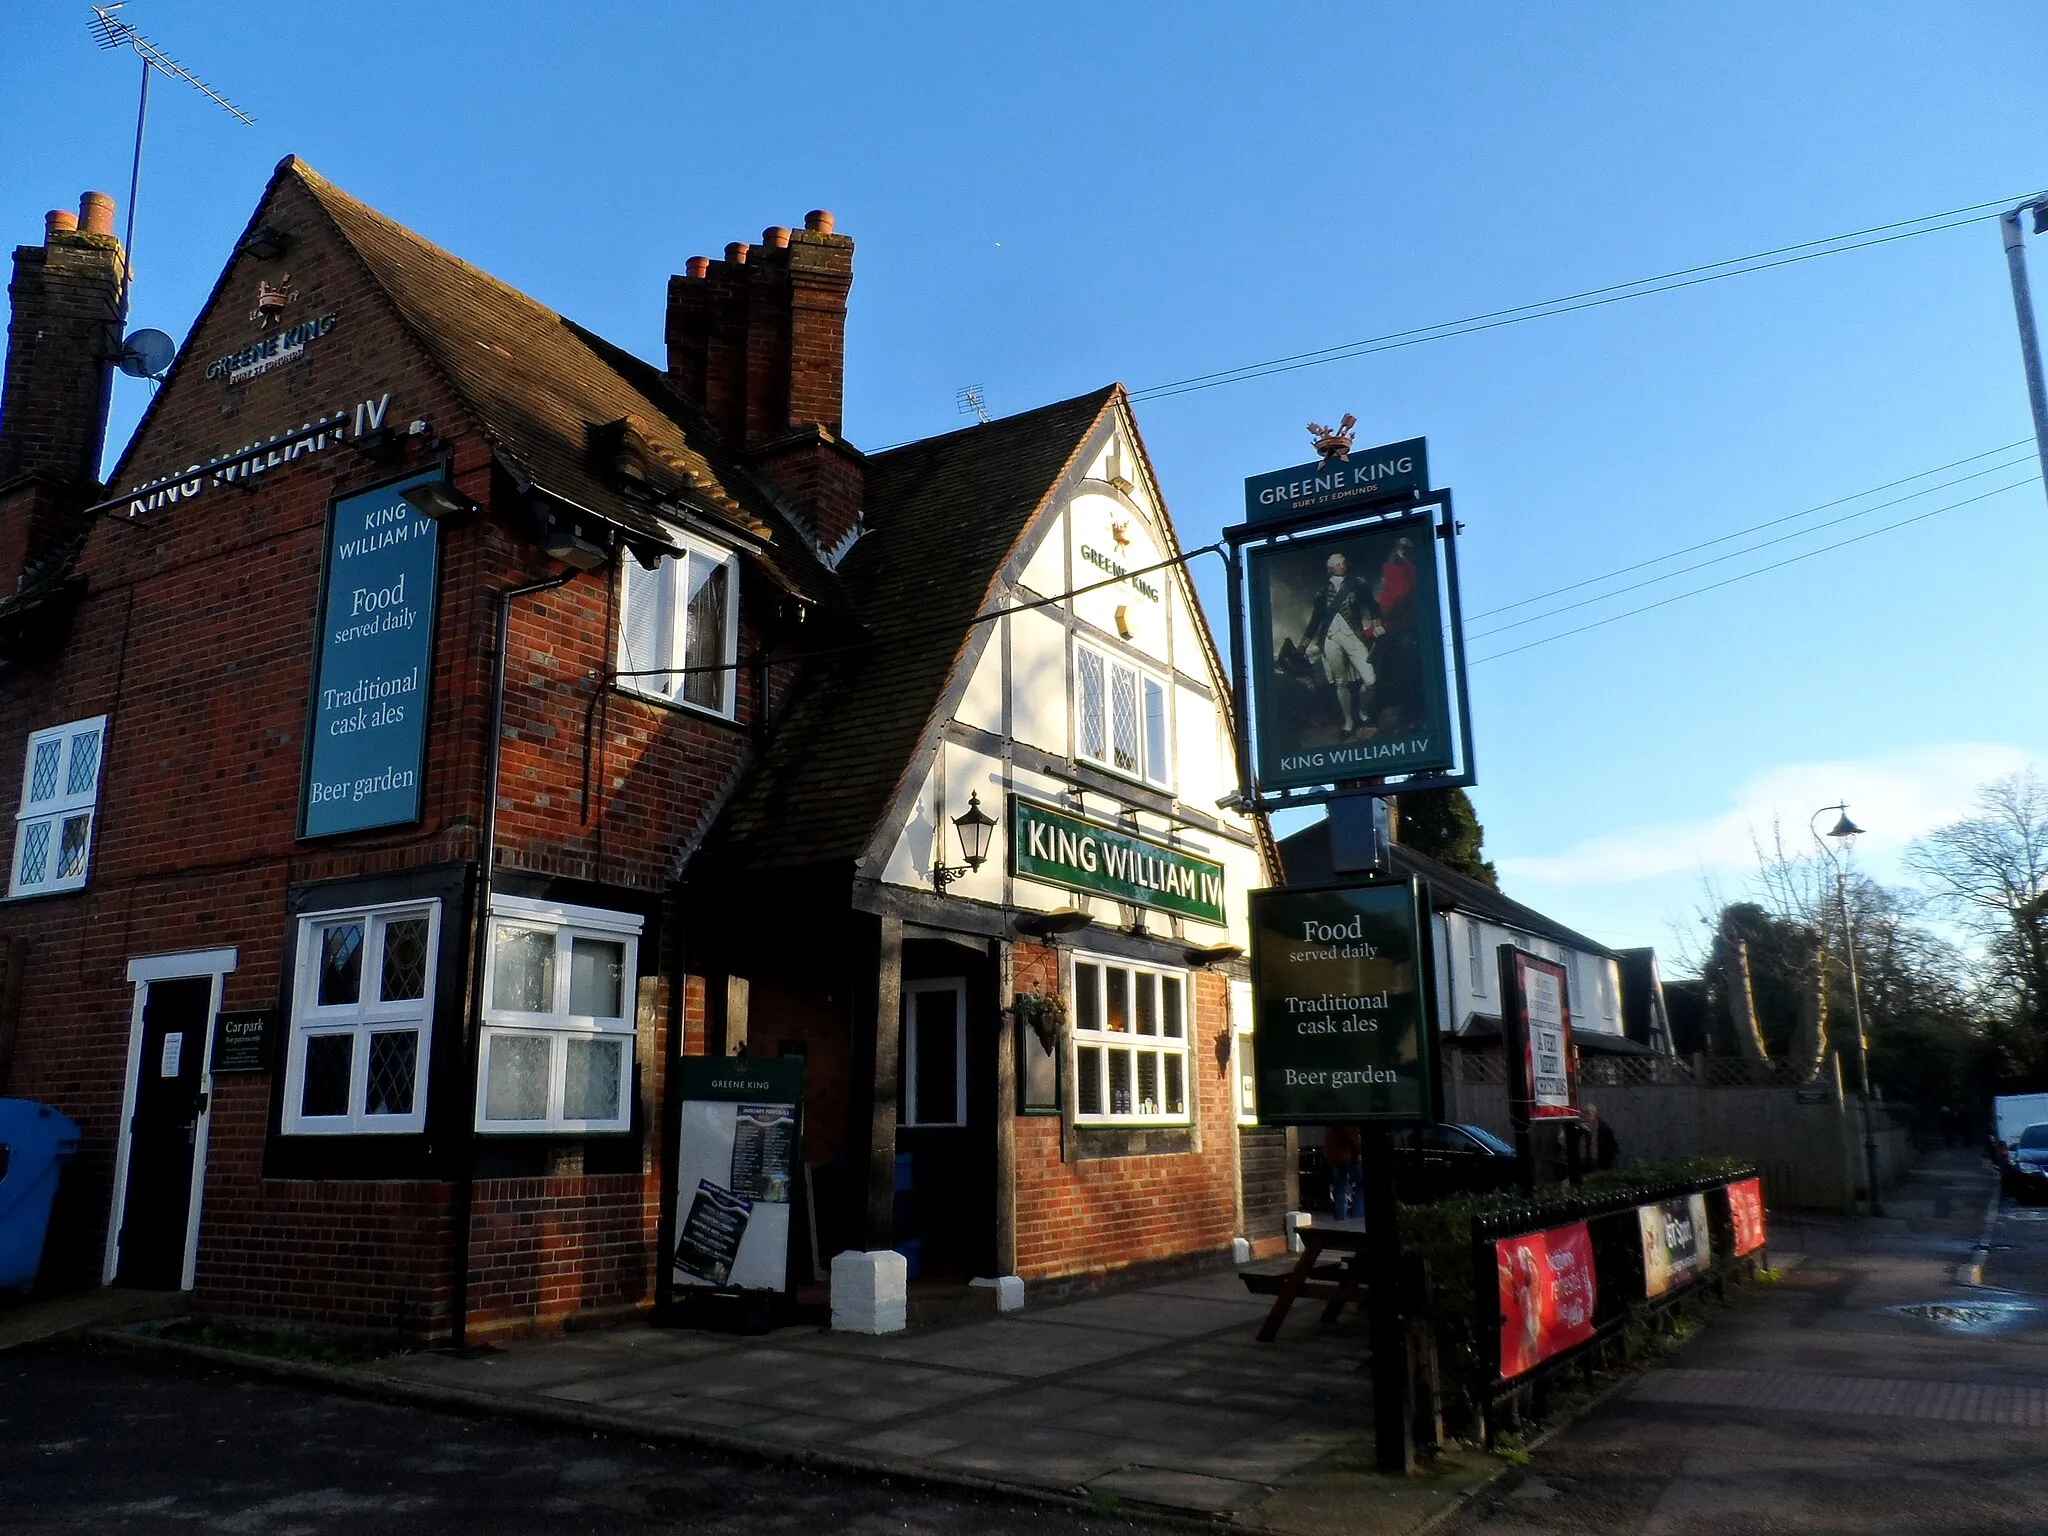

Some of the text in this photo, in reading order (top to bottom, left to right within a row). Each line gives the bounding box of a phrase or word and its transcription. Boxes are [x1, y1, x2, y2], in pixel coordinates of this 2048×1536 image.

[206, 314, 336, 380] GREENE KING
[129, 393, 391, 517] KING WILLIAM IV
[1260, 457, 1413, 505] GREENE KING
[1292, 484, 1378, 509] BURY ST EDMUNDS
[365, 503, 407, 530] KING
[339, 518, 431, 560] WILLIAM IV
[1081, 544, 1127, 583] GREENE
[1131, 577, 1159, 603] KING
[350, 573, 404, 617] Food
[334, 607, 417, 644] served daily
[323, 667, 418, 710] Traditional
[330, 701, 404, 736] cask ales
[1281, 738, 1429, 771] KING WILLIAM IV
[310, 766, 414, 804] Beer garden
[1027, 819, 1220, 906] KING WILLIAM IV
[1302, 914, 1363, 942] Food
[1289, 943, 1378, 962] served daily
[1285, 990, 1389, 1013] Traditional
[225, 1018, 264, 1035] Car park
[1297, 1014, 1378, 1034] cask ales
[711, 1080, 770, 1089] GREENE KING
[1285, 1065, 1398, 1088] Beer garden
